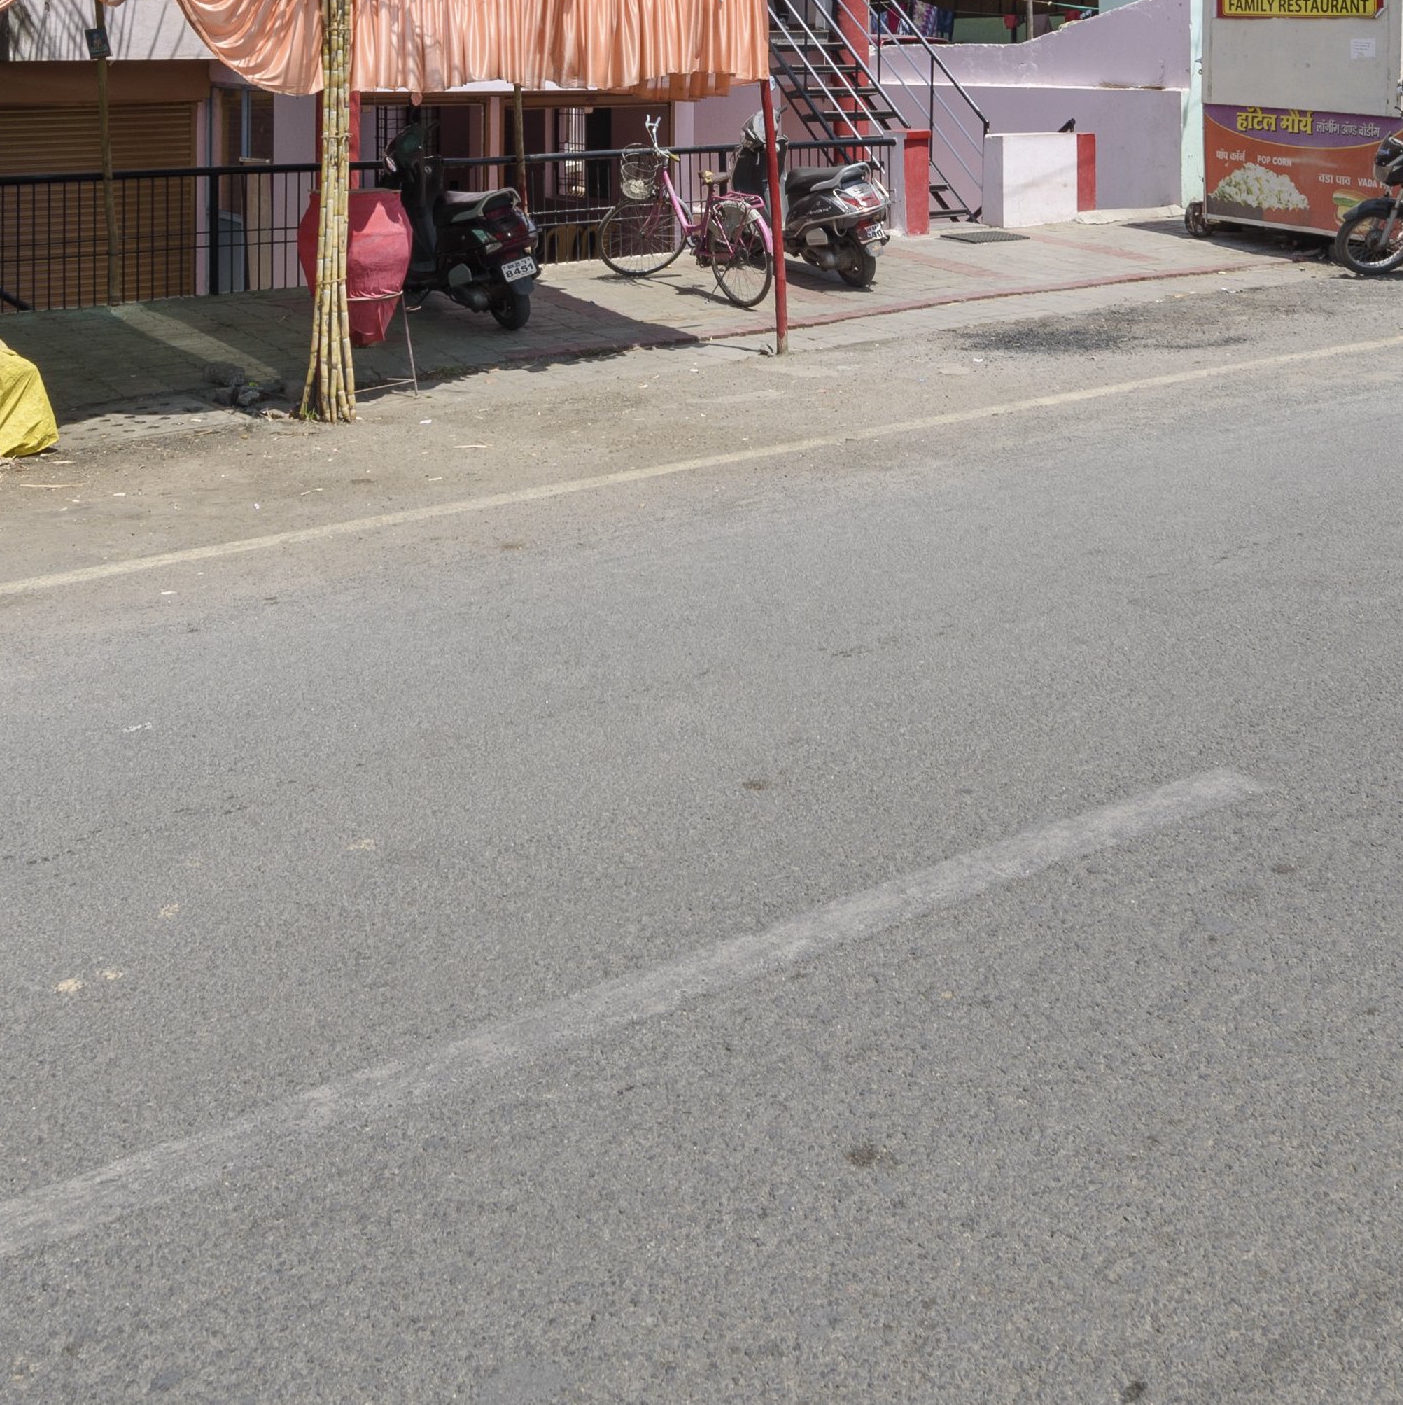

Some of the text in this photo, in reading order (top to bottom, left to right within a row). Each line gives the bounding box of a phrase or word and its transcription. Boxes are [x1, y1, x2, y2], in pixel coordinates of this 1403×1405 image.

[1278, 0, 1369, 14] RESTAURANT
[1236, 106, 1277, 132] हॉटेल
[1257, 155, 1292, 167] POP CORN
